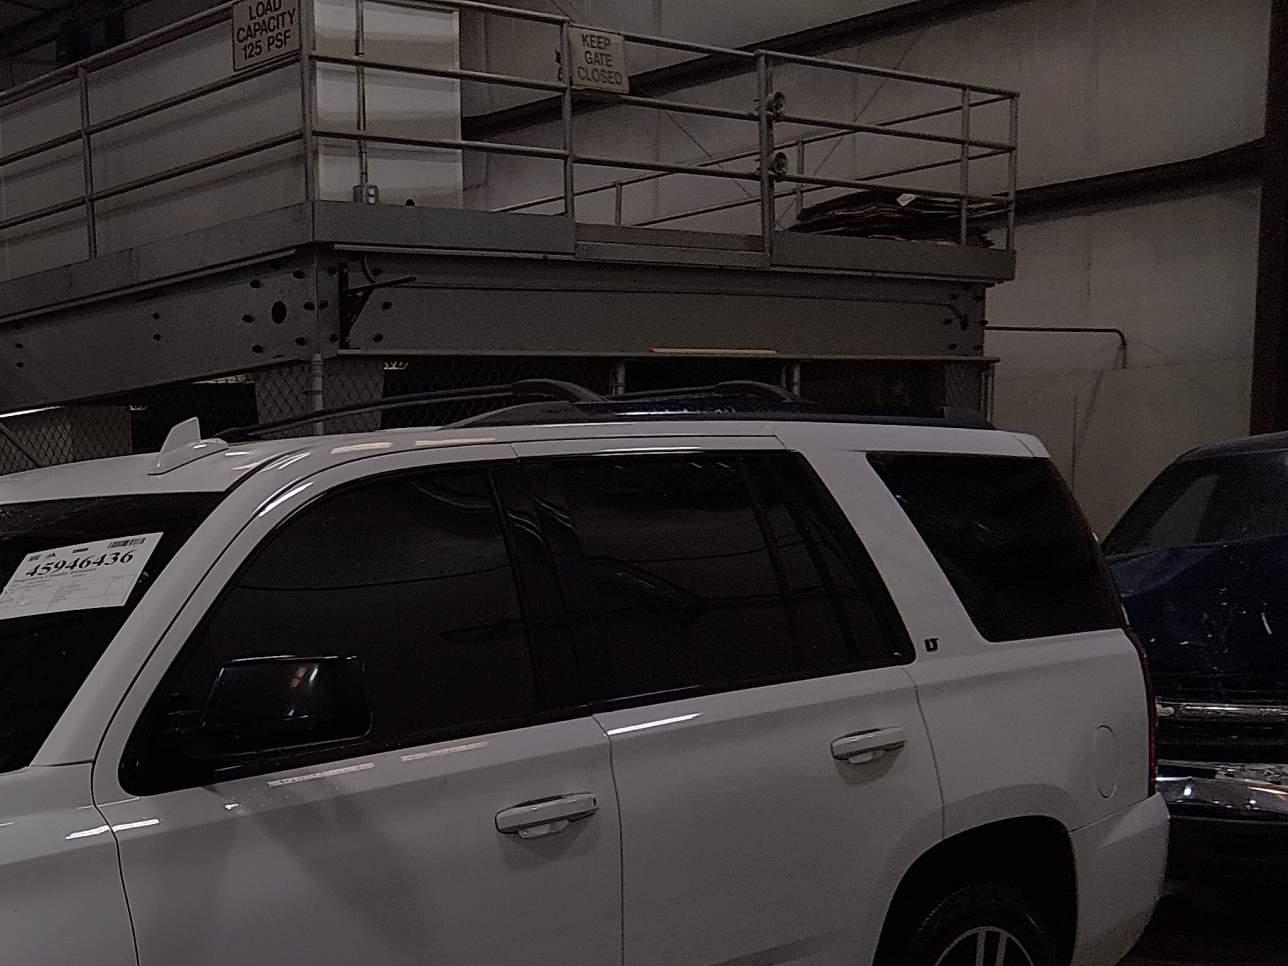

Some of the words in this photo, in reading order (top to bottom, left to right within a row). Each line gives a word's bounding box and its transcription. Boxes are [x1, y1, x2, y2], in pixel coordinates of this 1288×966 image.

[248, 0, 282, 21] LOAD
[236, 8, 296, 43] CAPACITY
[242, 40, 262, 60] 125
[267, 29, 291, 52] PSF
[581, 33, 610, 50] KEEP
[584, 50, 613, 68] GATE
[577, 66, 623, 85] CLOSED
[25, 550, 135, 577] 45946436
[924, 638, 939, 652] LT
